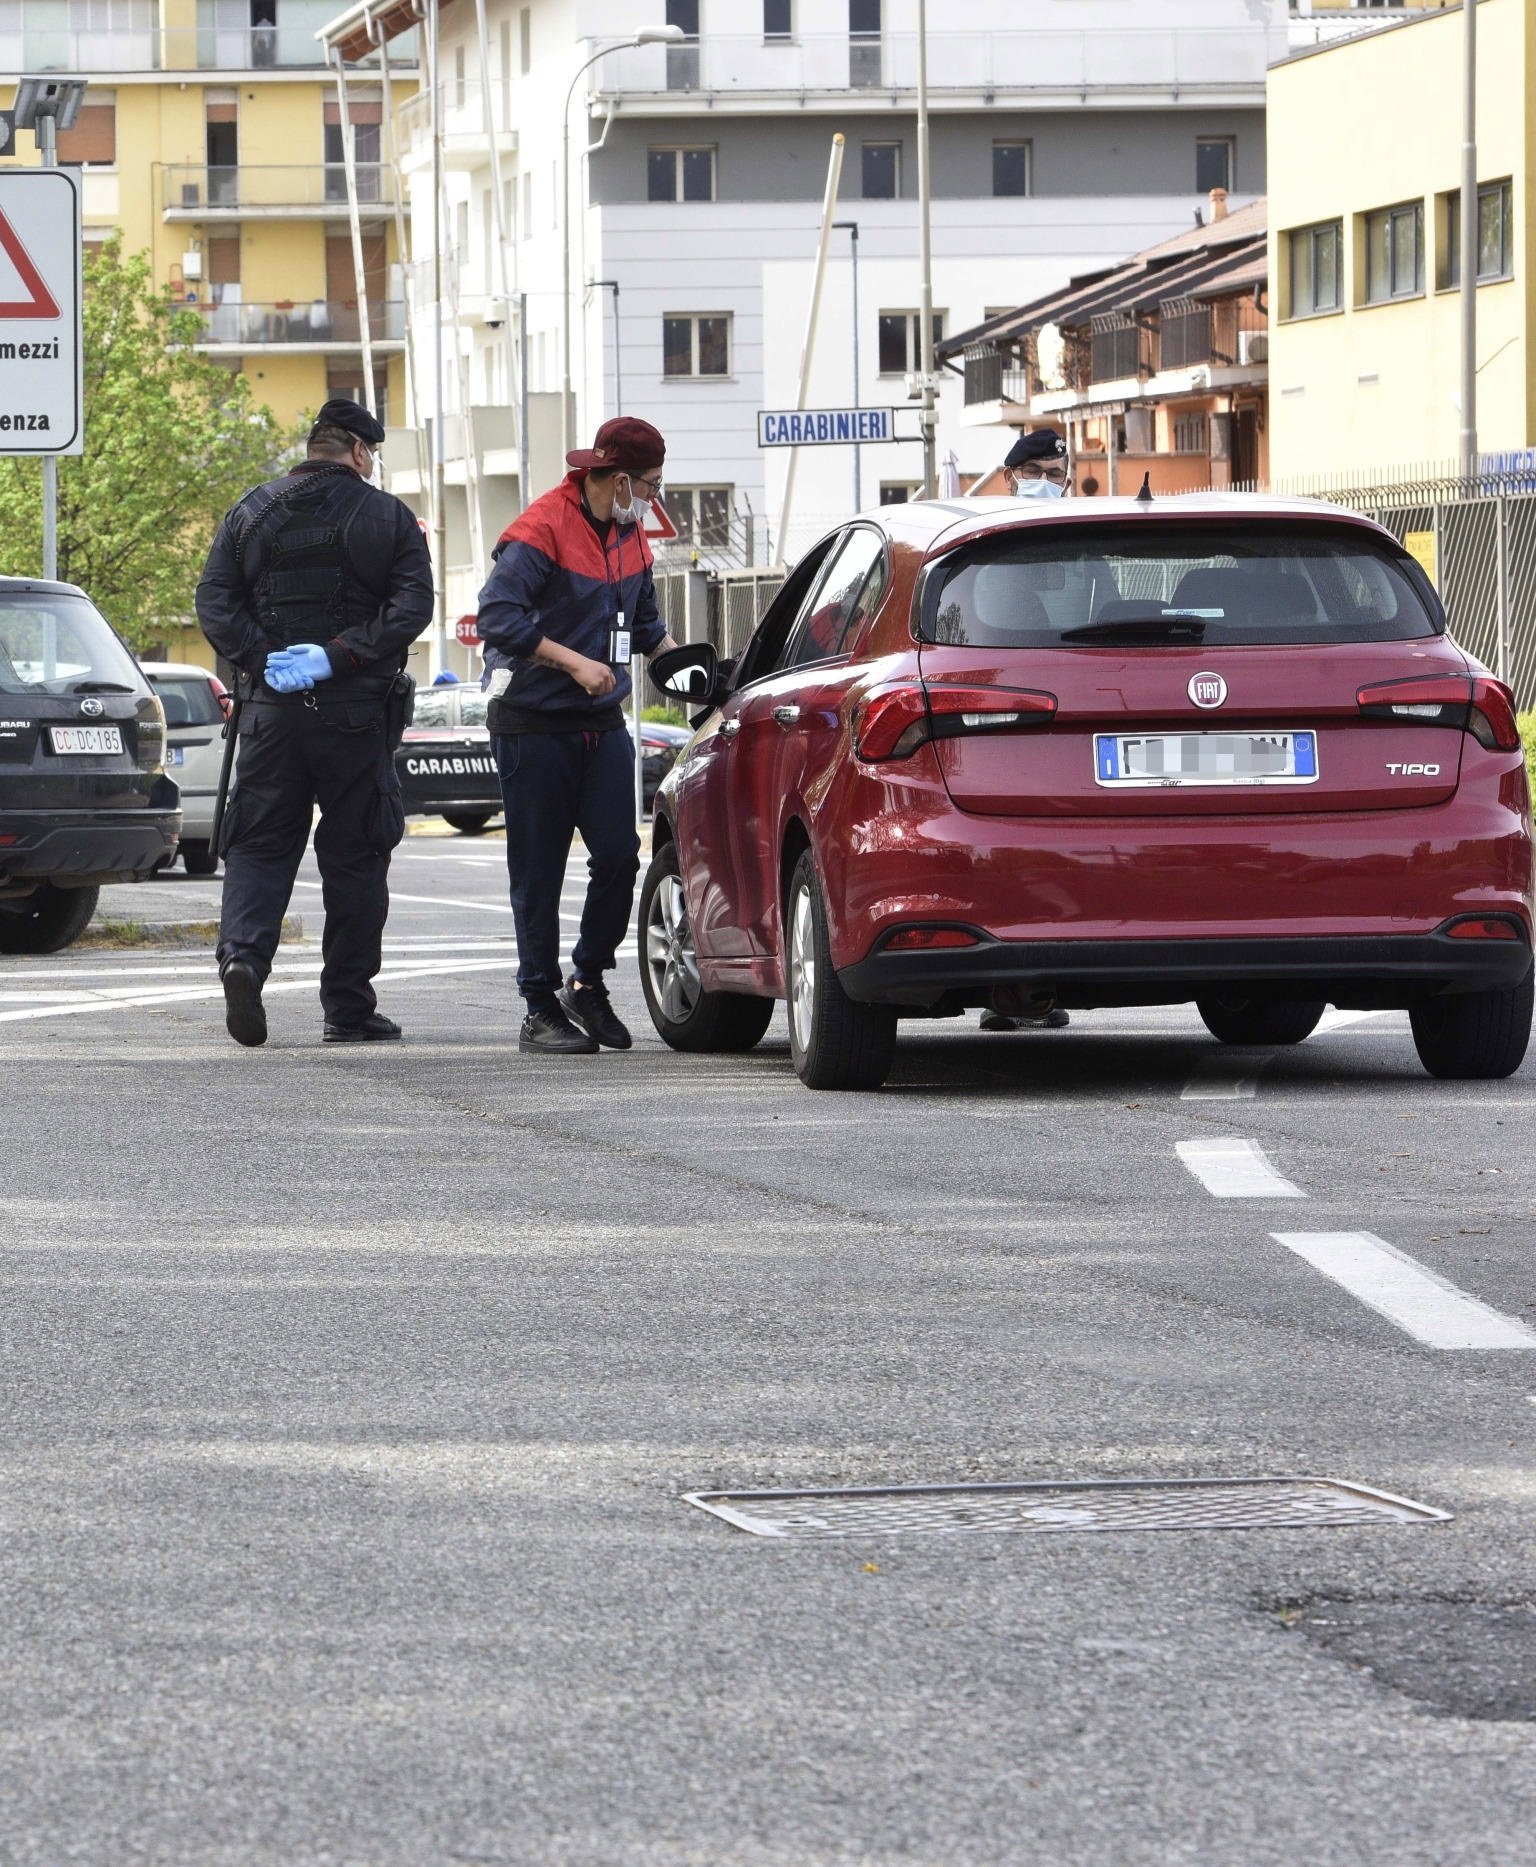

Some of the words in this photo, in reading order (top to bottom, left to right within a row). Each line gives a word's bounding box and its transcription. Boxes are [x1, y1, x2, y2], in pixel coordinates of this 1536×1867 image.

[765, 412, 886, 442] CARABINIERI
[456, 623, 478, 637] STO
[1197, 682, 1219, 699] FIAT
[407, 758, 498, 775] CARABINIE
[1386, 763, 1440, 776] TIPO
